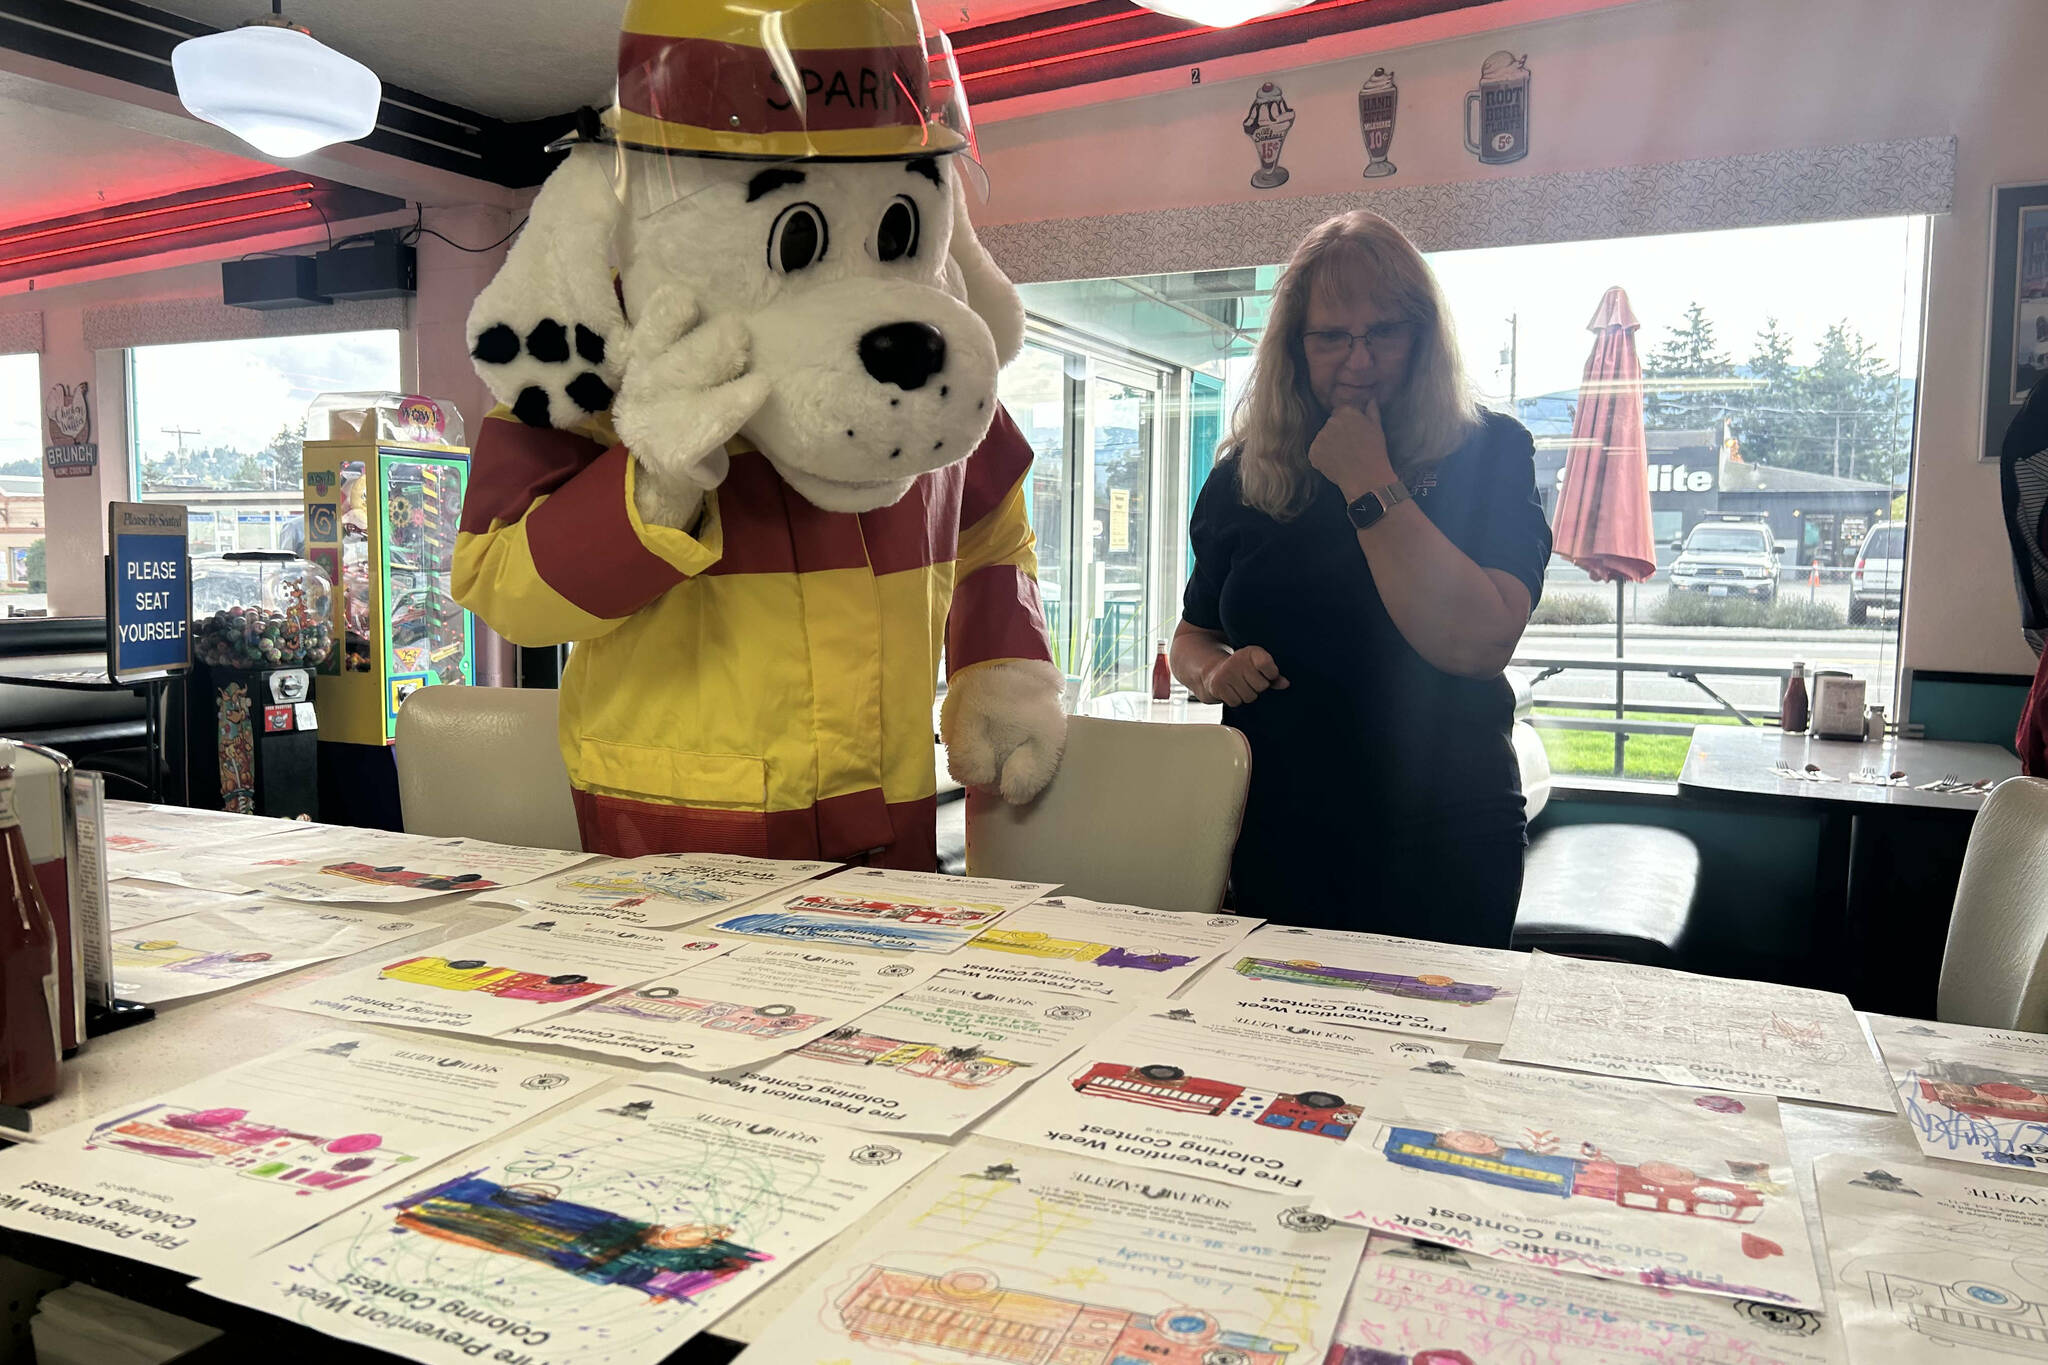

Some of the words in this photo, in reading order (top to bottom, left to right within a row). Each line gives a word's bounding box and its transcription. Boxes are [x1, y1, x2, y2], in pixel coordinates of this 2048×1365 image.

[766, 67, 921, 111] SPARK
[47, 445, 94, 466] BRUNCH
[123, 512, 148, 527] Please
[148, 513, 157, 527] Be
[158, 513, 183, 528] Seated
[127, 561, 177, 580] PLEASE
[135, 591, 171, 611] SEAT
[118, 620, 187, 643] YOURSELF
[939, 968, 981, 978] Wee
[963, 964, 1028, 977] Contest
[1031, 971, 1104, 987] Coloring
[985, 974, 1077, 990] Prevention
[341, 995, 405, 1012] Contest
[1235, 1000, 1289, 1014] Week
[1259, 996, 1338, 1011] Contest
[1295, 1008, 1402, 1027] Prevention
[1343, 1005, 1429, 1023] Coloring
[545, 1025, 616, 1039] Contest
[1407, 1022, 1448, 1034] Fire
[562, 1034, 659, 1054] Prevention
[1566, 1056, 1630, 1072] Week
[1688, 1063, 1793, 1084] Coloring
[708, 1076, 758, 1094] Week
[738, 1071, 814, 1092] Contest
[1773, 1084, 1822, 1096] Fire
[761, 1088, 865, 1115] Prevention
[817, 1085, 900, 1109] Coloring
[868, 1109, 907, 1121] Fire
[1044, 1130, 1108, 1152] Week
[1079, 1123, 1173, 1149] Contest
[1114, 1143, 1247, 1177] Prevention
[1178, 1140, 1285, 1170] Coloring
[1253, 1169, 1304, 1189] Fire
[0, 1192, 30, 1212] We
[19, 1179, 105, 1207] Contest
[27, 1202, 144, 1240] Prevention
[103, 1198, 197, 1230] Coloring
[1427, 1206, 1544, 1242] Contest
[1393, 1213, 1473, 1242] Week
[141, 1231, 190, 1251] Fire
[1552, 1231, 1690, 1265] Coloring
[283, 1283, 352, 1314] Week
[336, 1272, 437, 1311] Contest
[352, 1304, 493, 1357] Prevention
[438, 1298, 552, 1346] Coloring
